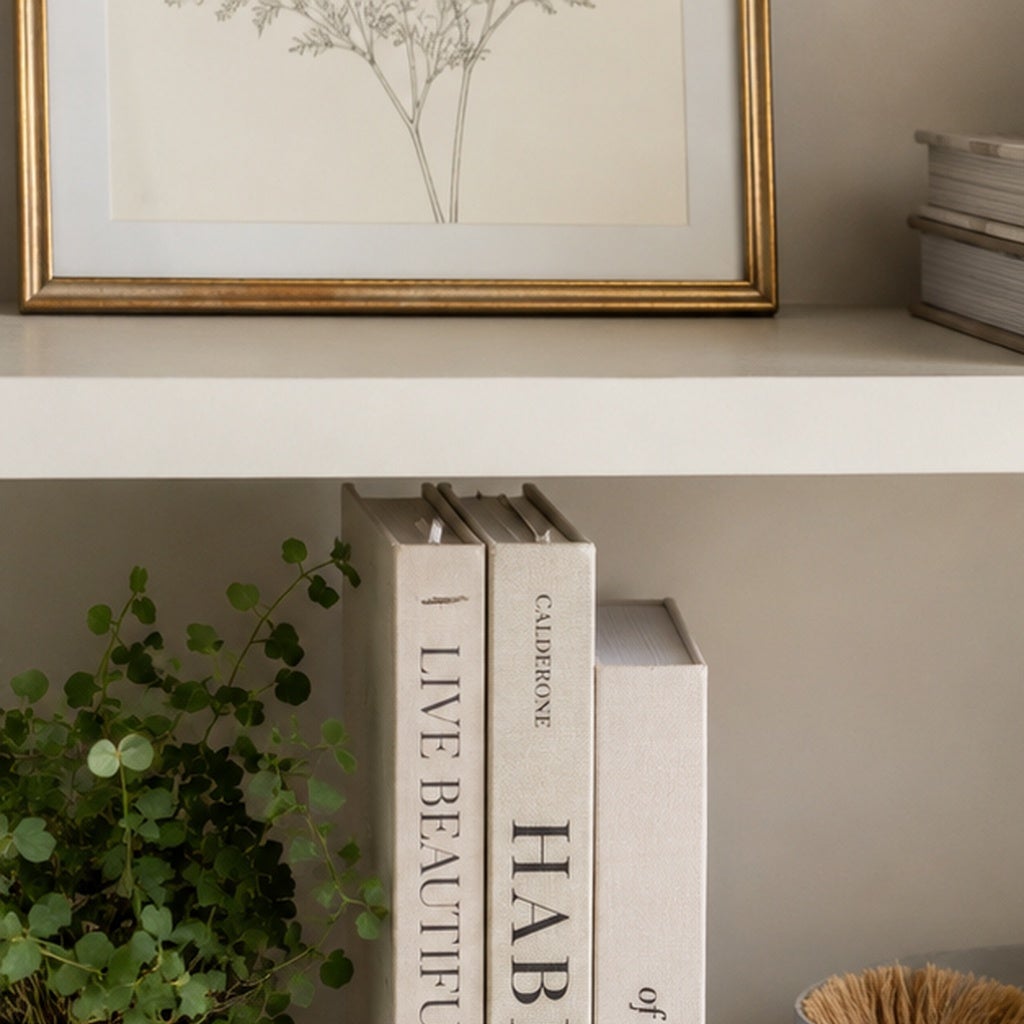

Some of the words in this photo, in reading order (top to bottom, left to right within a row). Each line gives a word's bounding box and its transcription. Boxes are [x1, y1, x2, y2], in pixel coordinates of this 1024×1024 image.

[420, 646, 461, 759] LIVE
[534, 594, 552, 728] CALDERONE
[628, 987, 667, 1020] of
